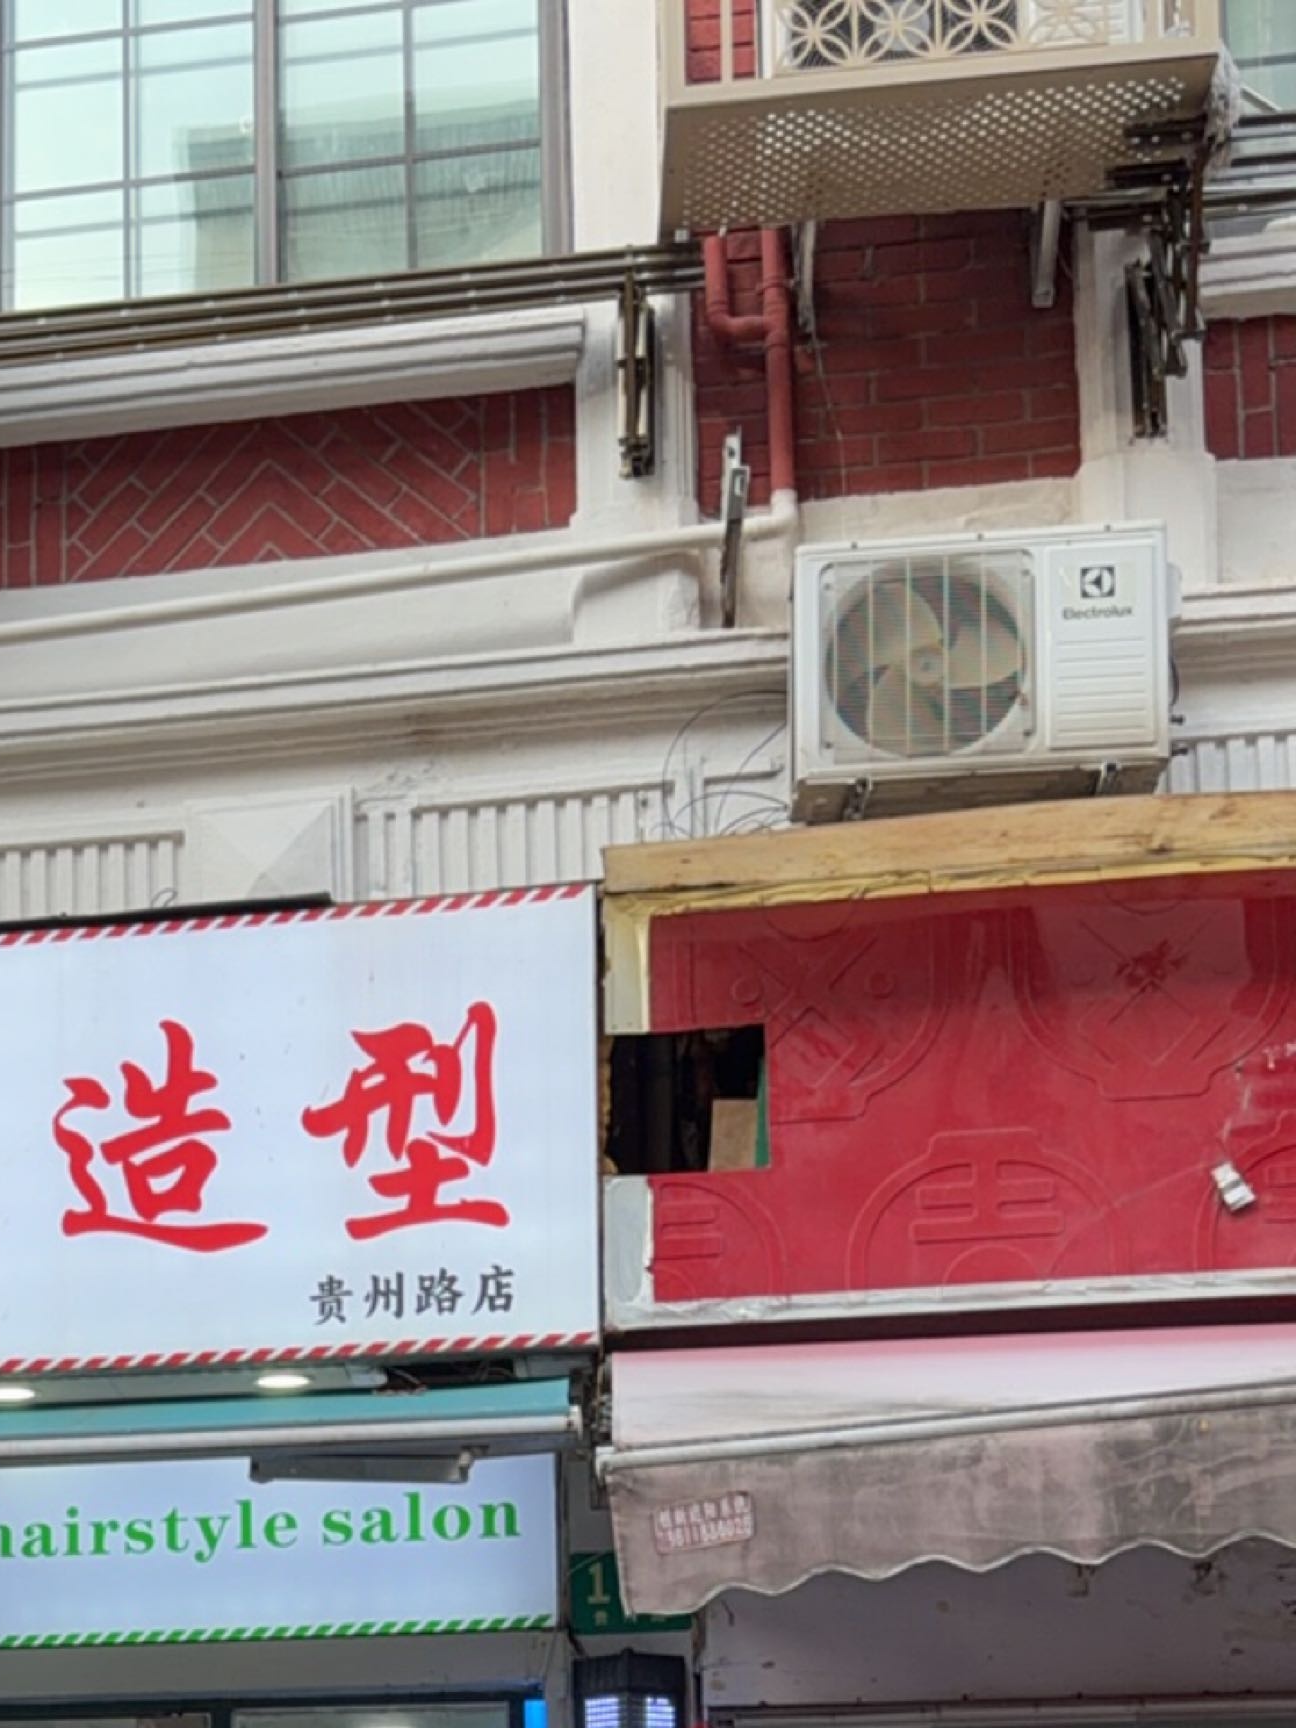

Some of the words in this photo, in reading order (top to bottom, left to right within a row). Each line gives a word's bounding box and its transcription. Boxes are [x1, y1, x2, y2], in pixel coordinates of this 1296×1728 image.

[1062, 605, 1132, 620] Electrolux
[308, 1264, 515, 1326] 贵州路店
[318, 1487, 522, 1552] salon
